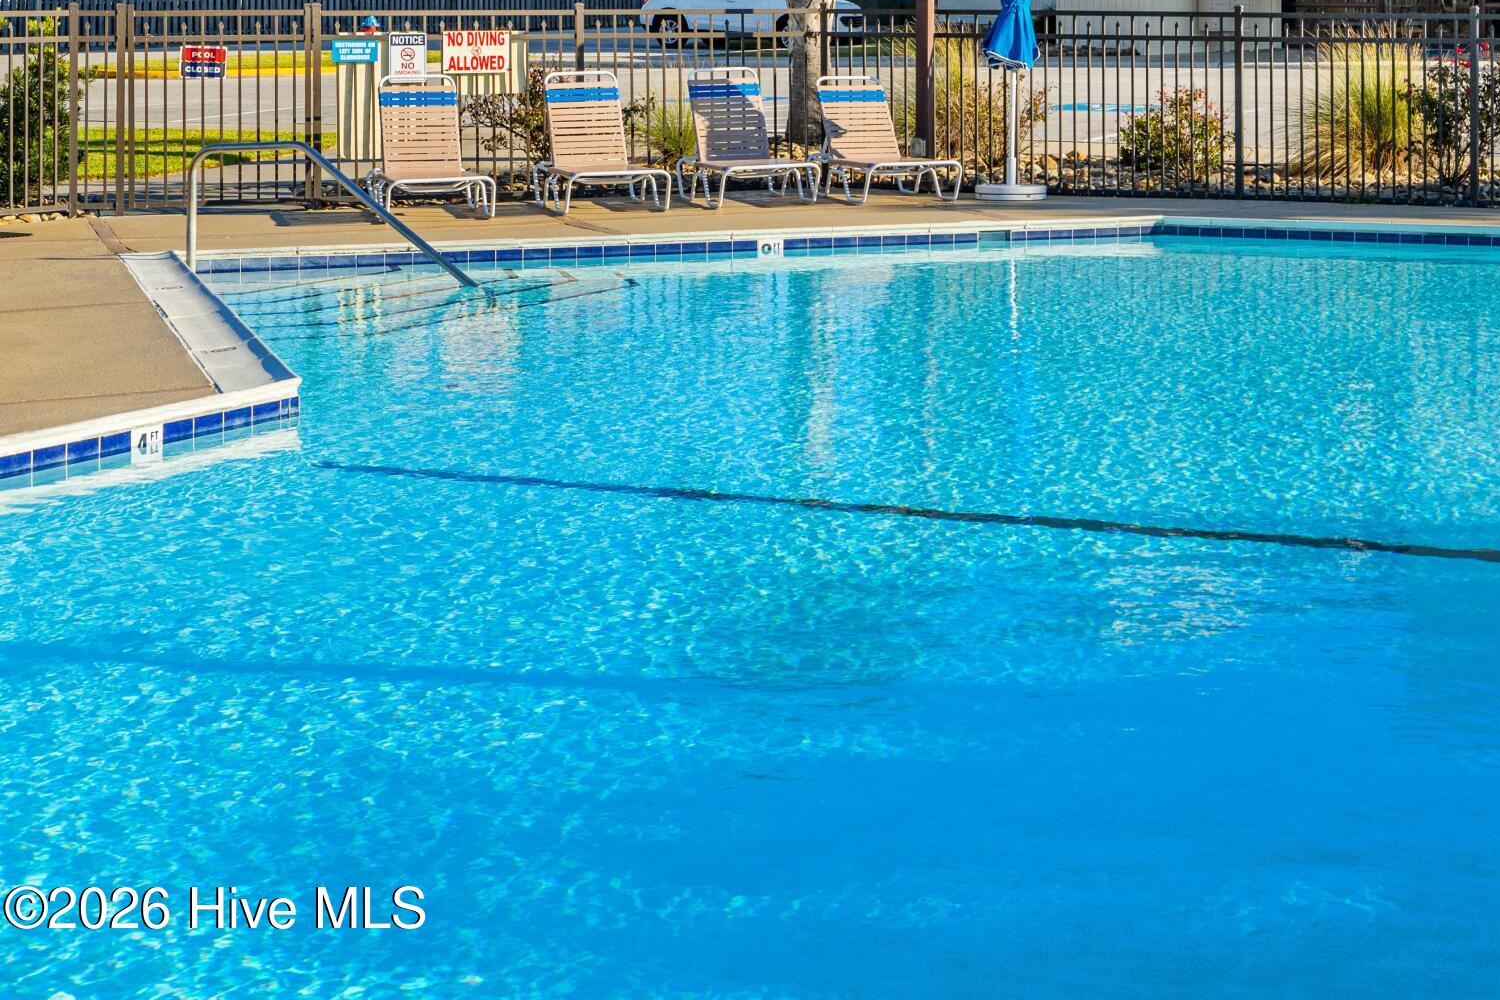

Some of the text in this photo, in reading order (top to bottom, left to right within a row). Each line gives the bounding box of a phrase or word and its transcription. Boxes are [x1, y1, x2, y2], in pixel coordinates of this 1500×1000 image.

[392, 35, 424, 45] NOTICE
[447, 31, 505, 47] NO DIVING
[401, 62, 415, 70] NO
[448, 55, 505, 71] ALLOWED
